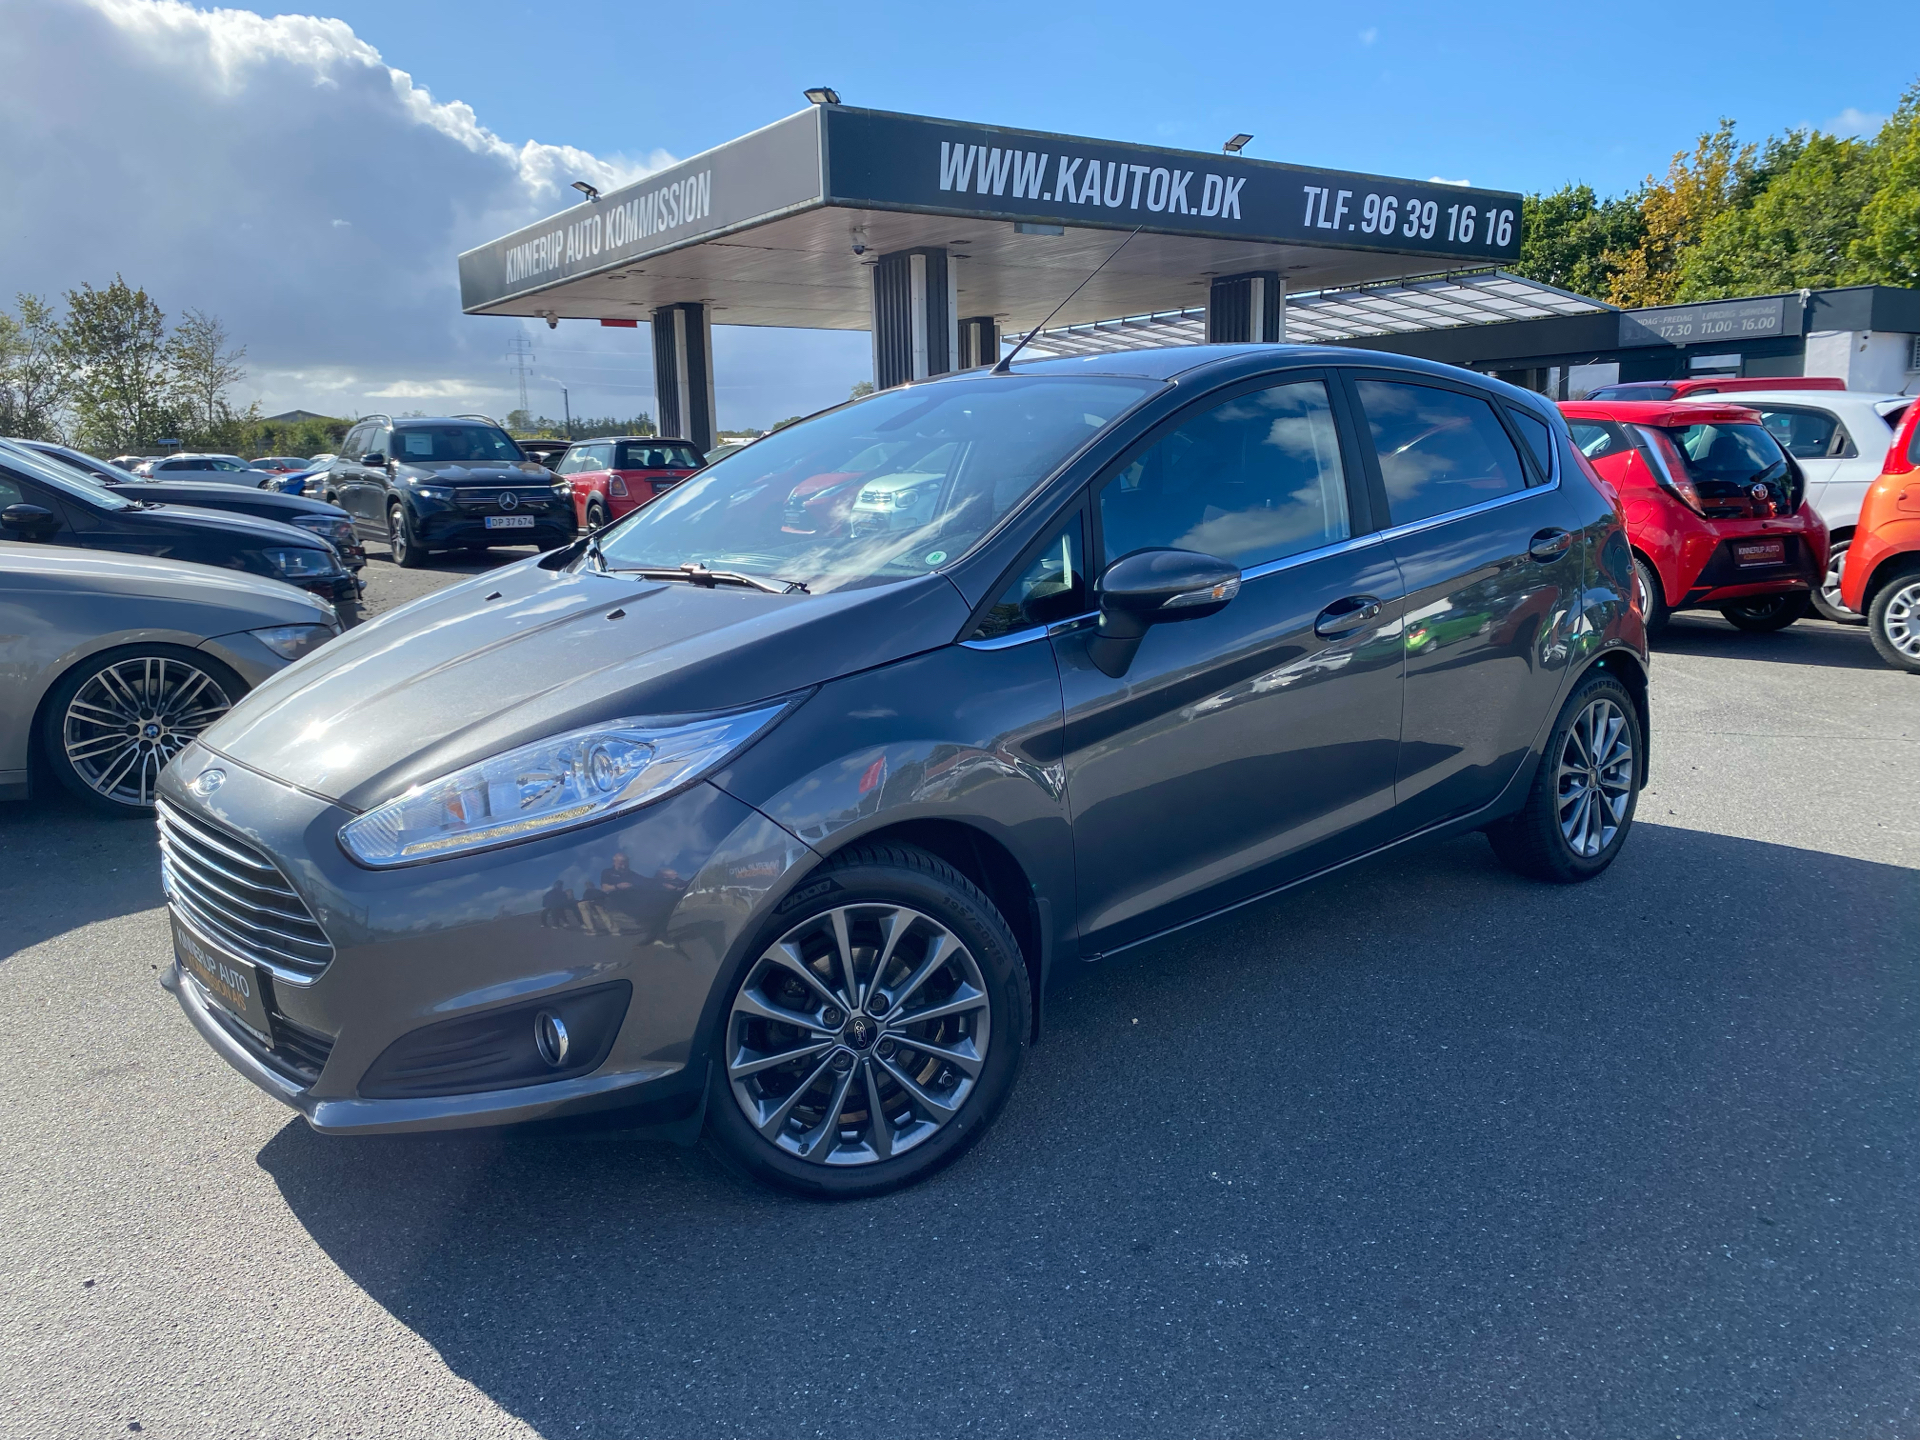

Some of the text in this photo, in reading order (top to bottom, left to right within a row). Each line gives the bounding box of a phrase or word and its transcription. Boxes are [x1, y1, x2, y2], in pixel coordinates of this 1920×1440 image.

[939, 141, 1246, 220] WWW.KAUTOK.DK
[506, 170, 711, 284] KINNERUP AUTO KOMMISSION
[1303, 185, 1514, 247] TLF. 96 39 16 16
[1660, 323, 1692, 338] 17.30
[1663, 314, 1693, 324] FREDAG
[1741, 316, 1776, 331] 16.00
[492, 518, 504, 527] DP
[505, 517, 516, 526] 37
[943, 896, 1005, 966] 195/50R16
[219, 962, 250, 998] AUTO
